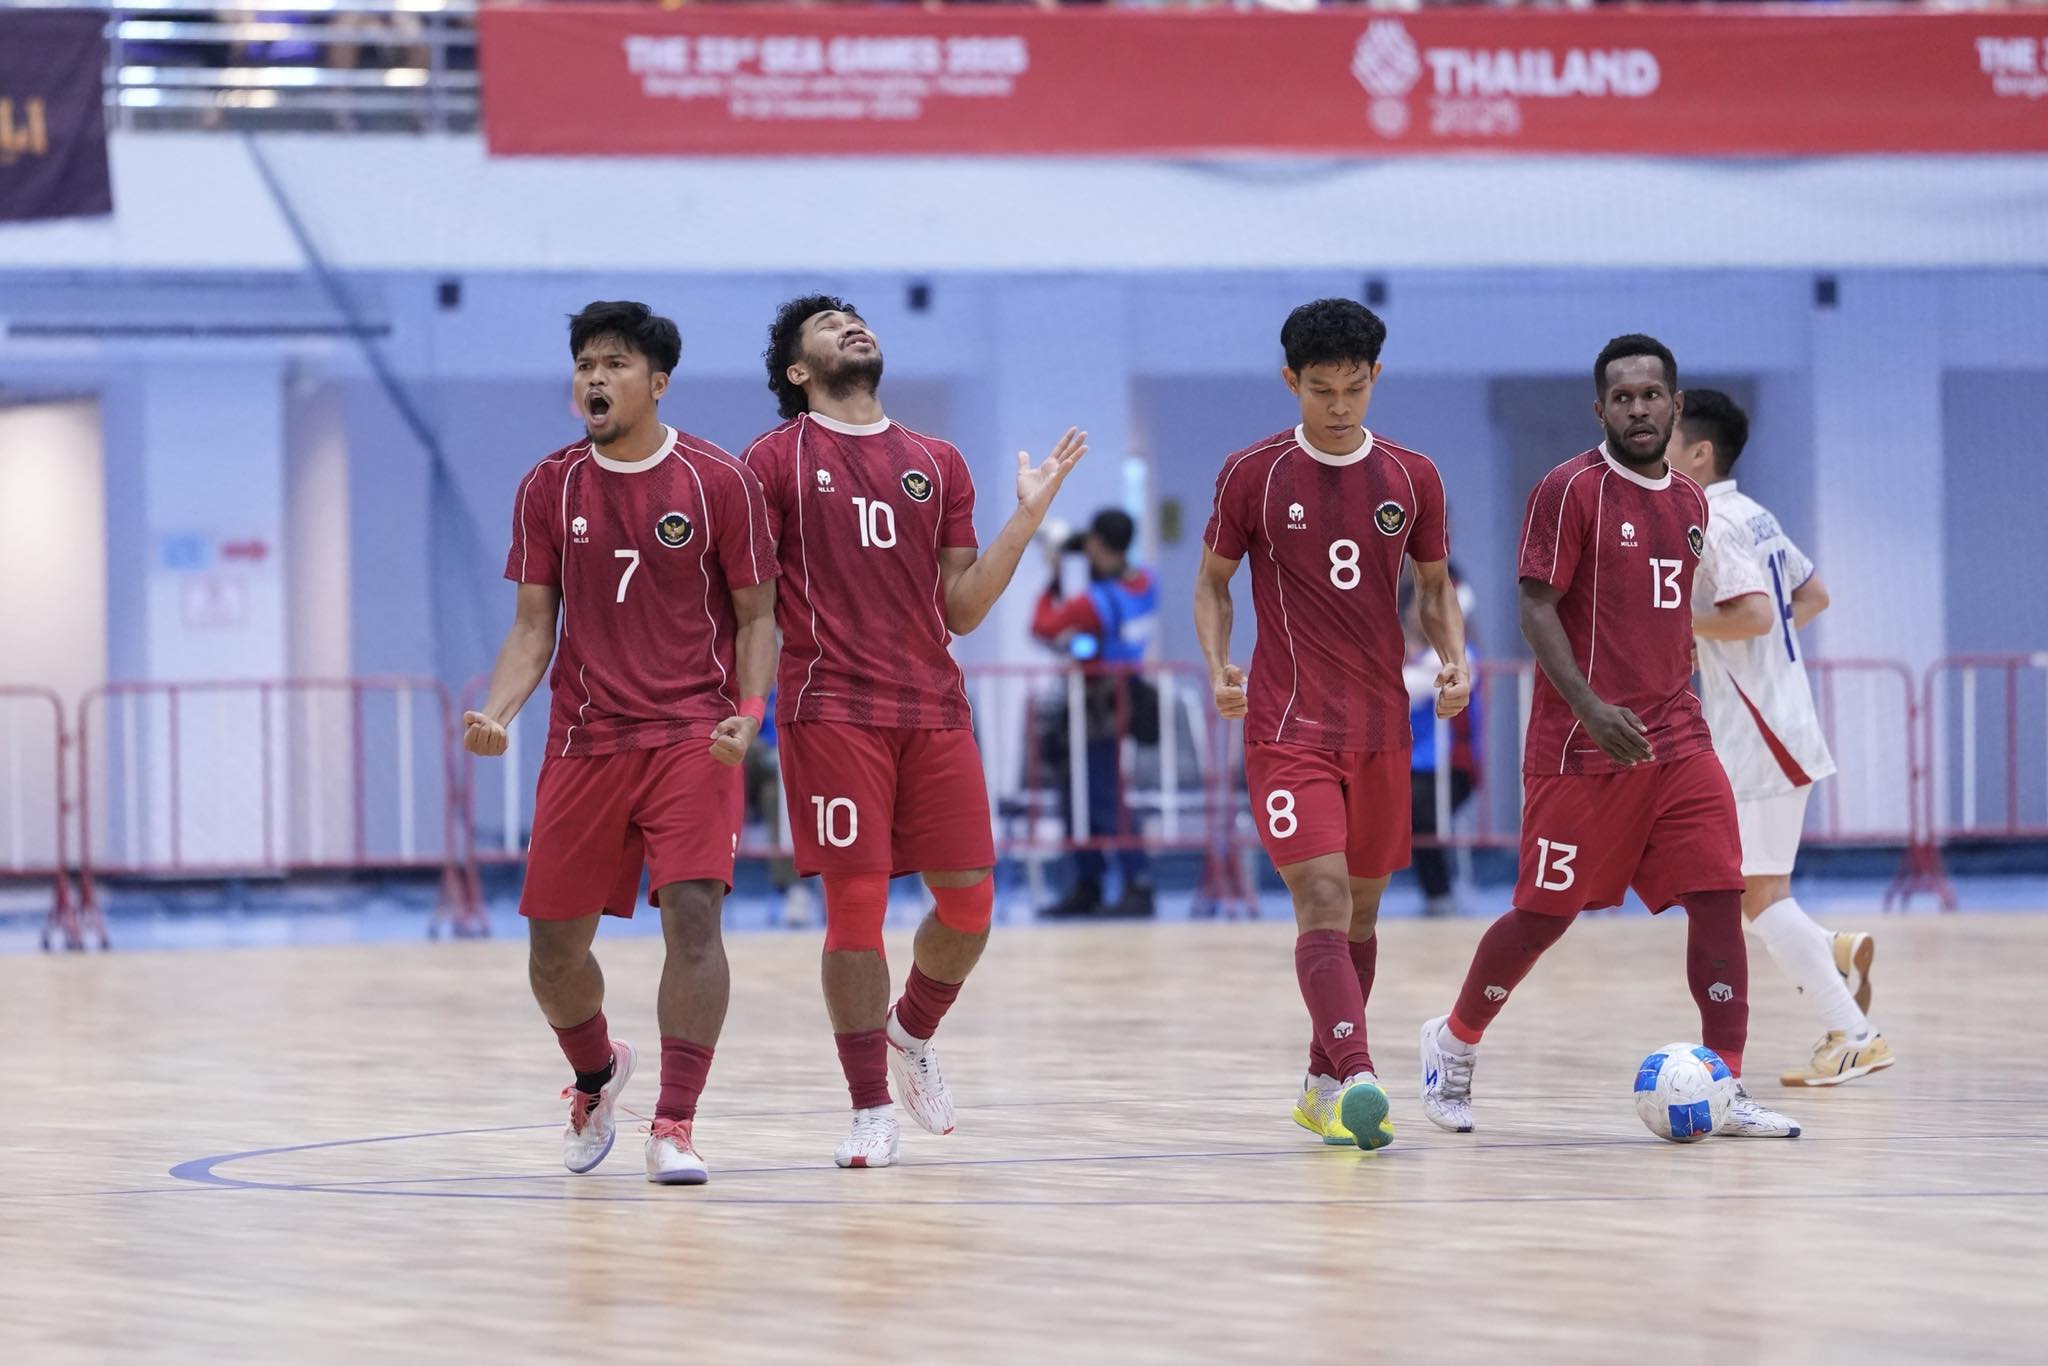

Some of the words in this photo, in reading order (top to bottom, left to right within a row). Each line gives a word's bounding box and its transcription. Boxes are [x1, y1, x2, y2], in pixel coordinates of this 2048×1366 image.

[760, 36, 824, 73] SEA
[829, 36, 941, 73] GAMES
[1426, 48, 1660, 96] THAILAND
[851, 496, 897, 549] 10
[614, 549, 640, 603] 7
[1328, 538, 1361, 591] 8
[1648, 557, 1683, 609] 13
[811, 795, 858, 848] 10
[1265, 789, 1298, 839] 8
[1535, 837, 1577, 892] 13
